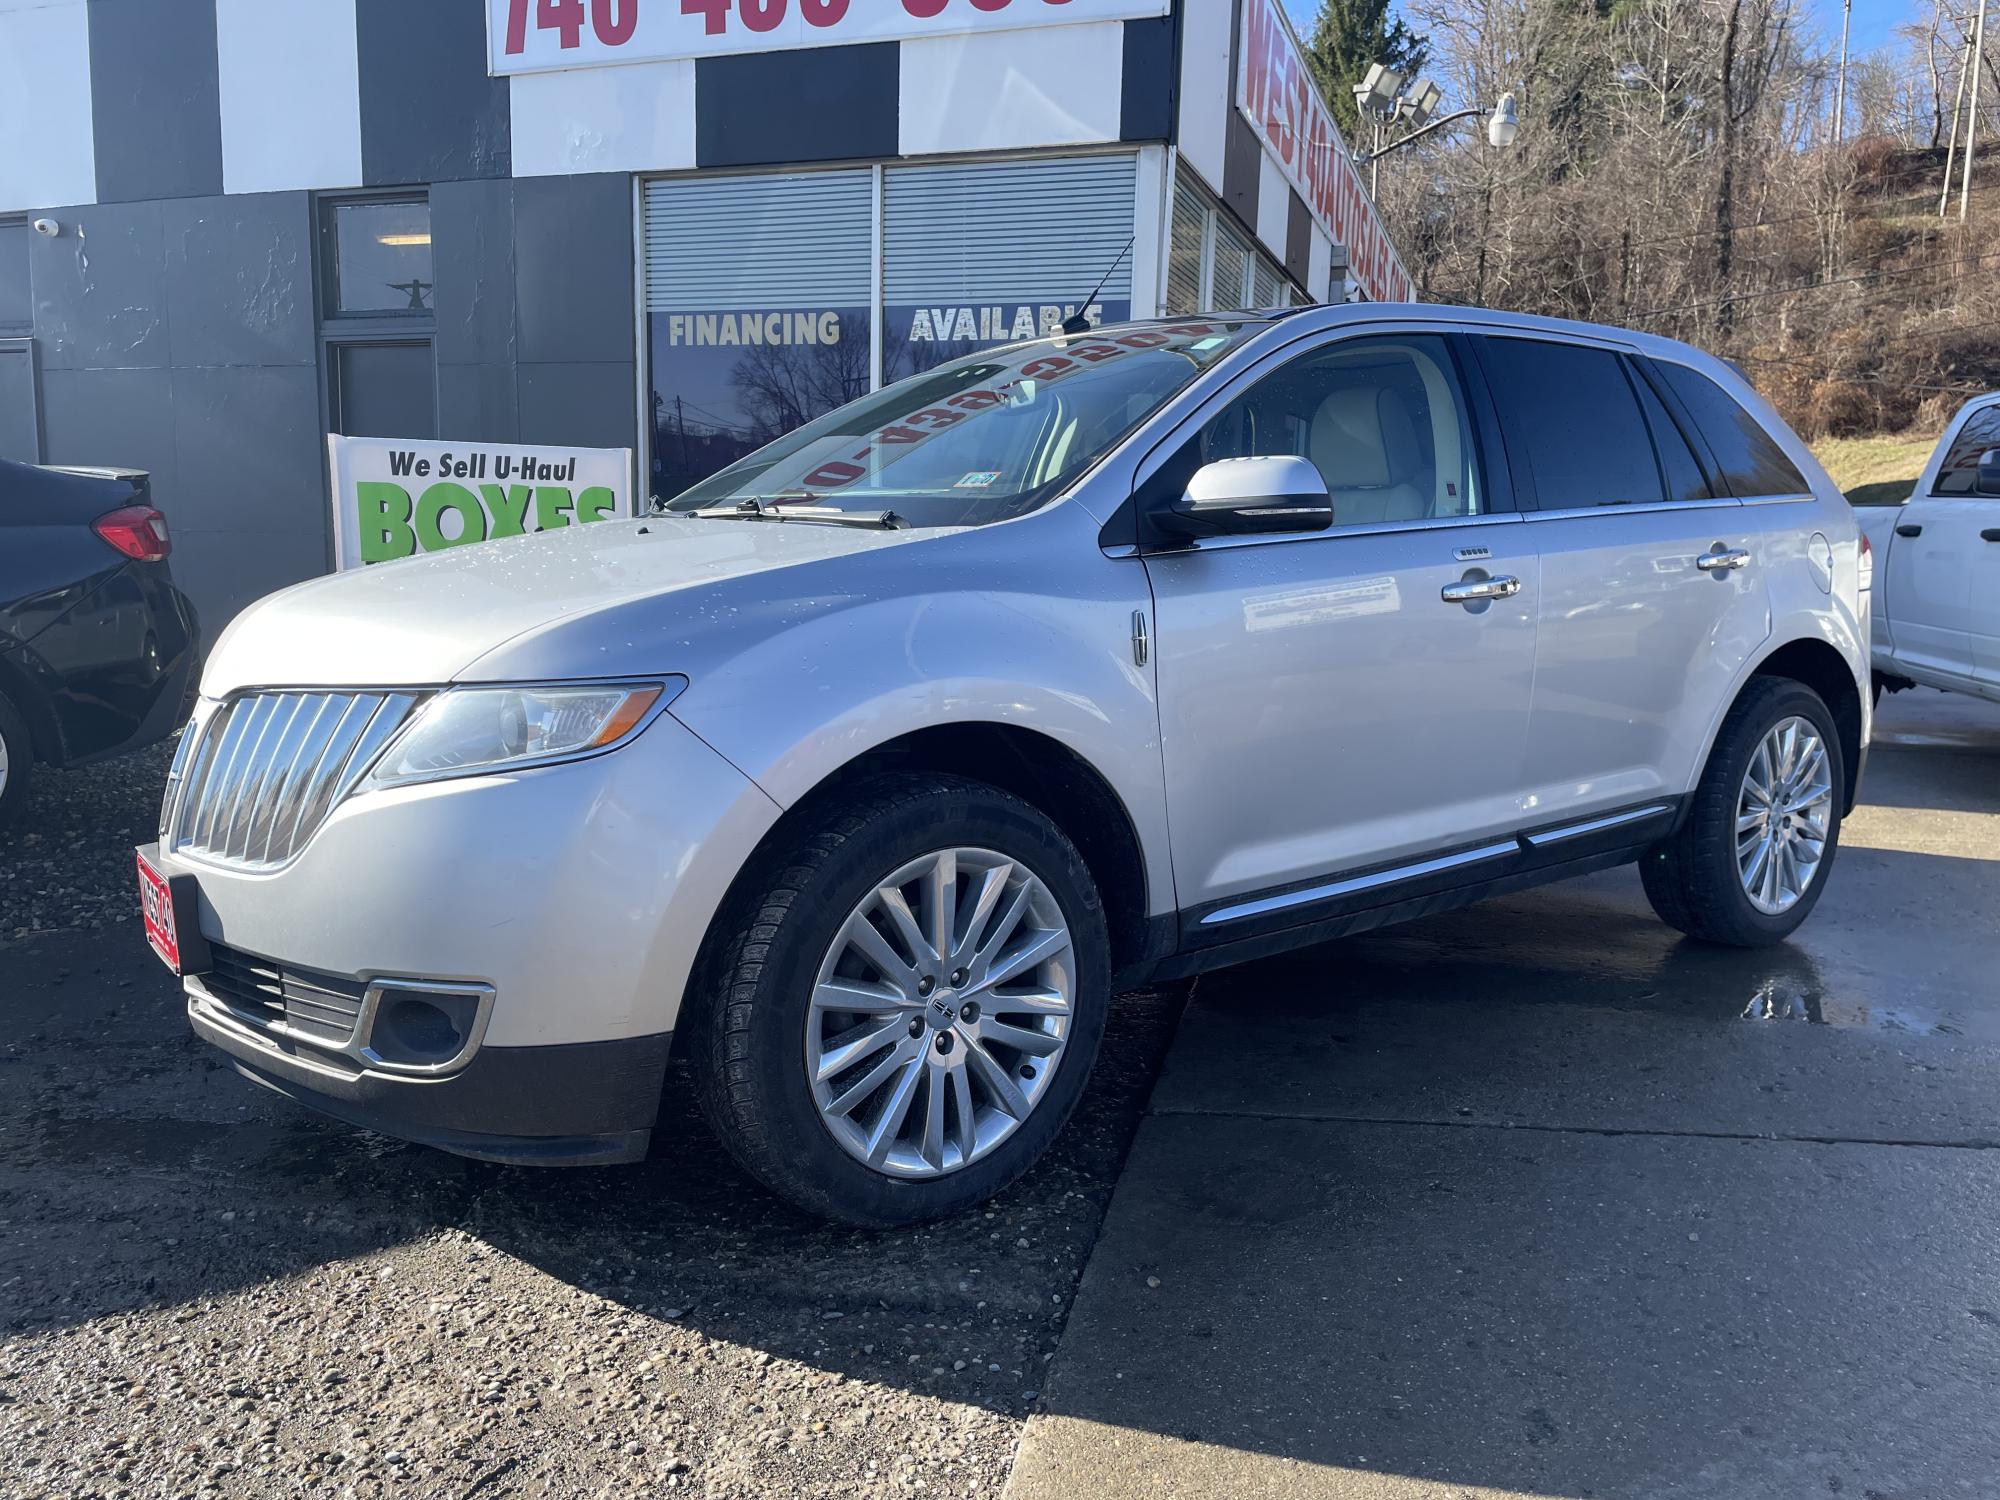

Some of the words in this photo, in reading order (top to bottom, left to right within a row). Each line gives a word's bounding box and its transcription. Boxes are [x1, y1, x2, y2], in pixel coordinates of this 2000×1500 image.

[670, 311, 840, 346] FINANCING
[389, 451, 430, 477] We
[438, 453, 486, 479] Sell
[495, 456, 576, 482] U-Haul
